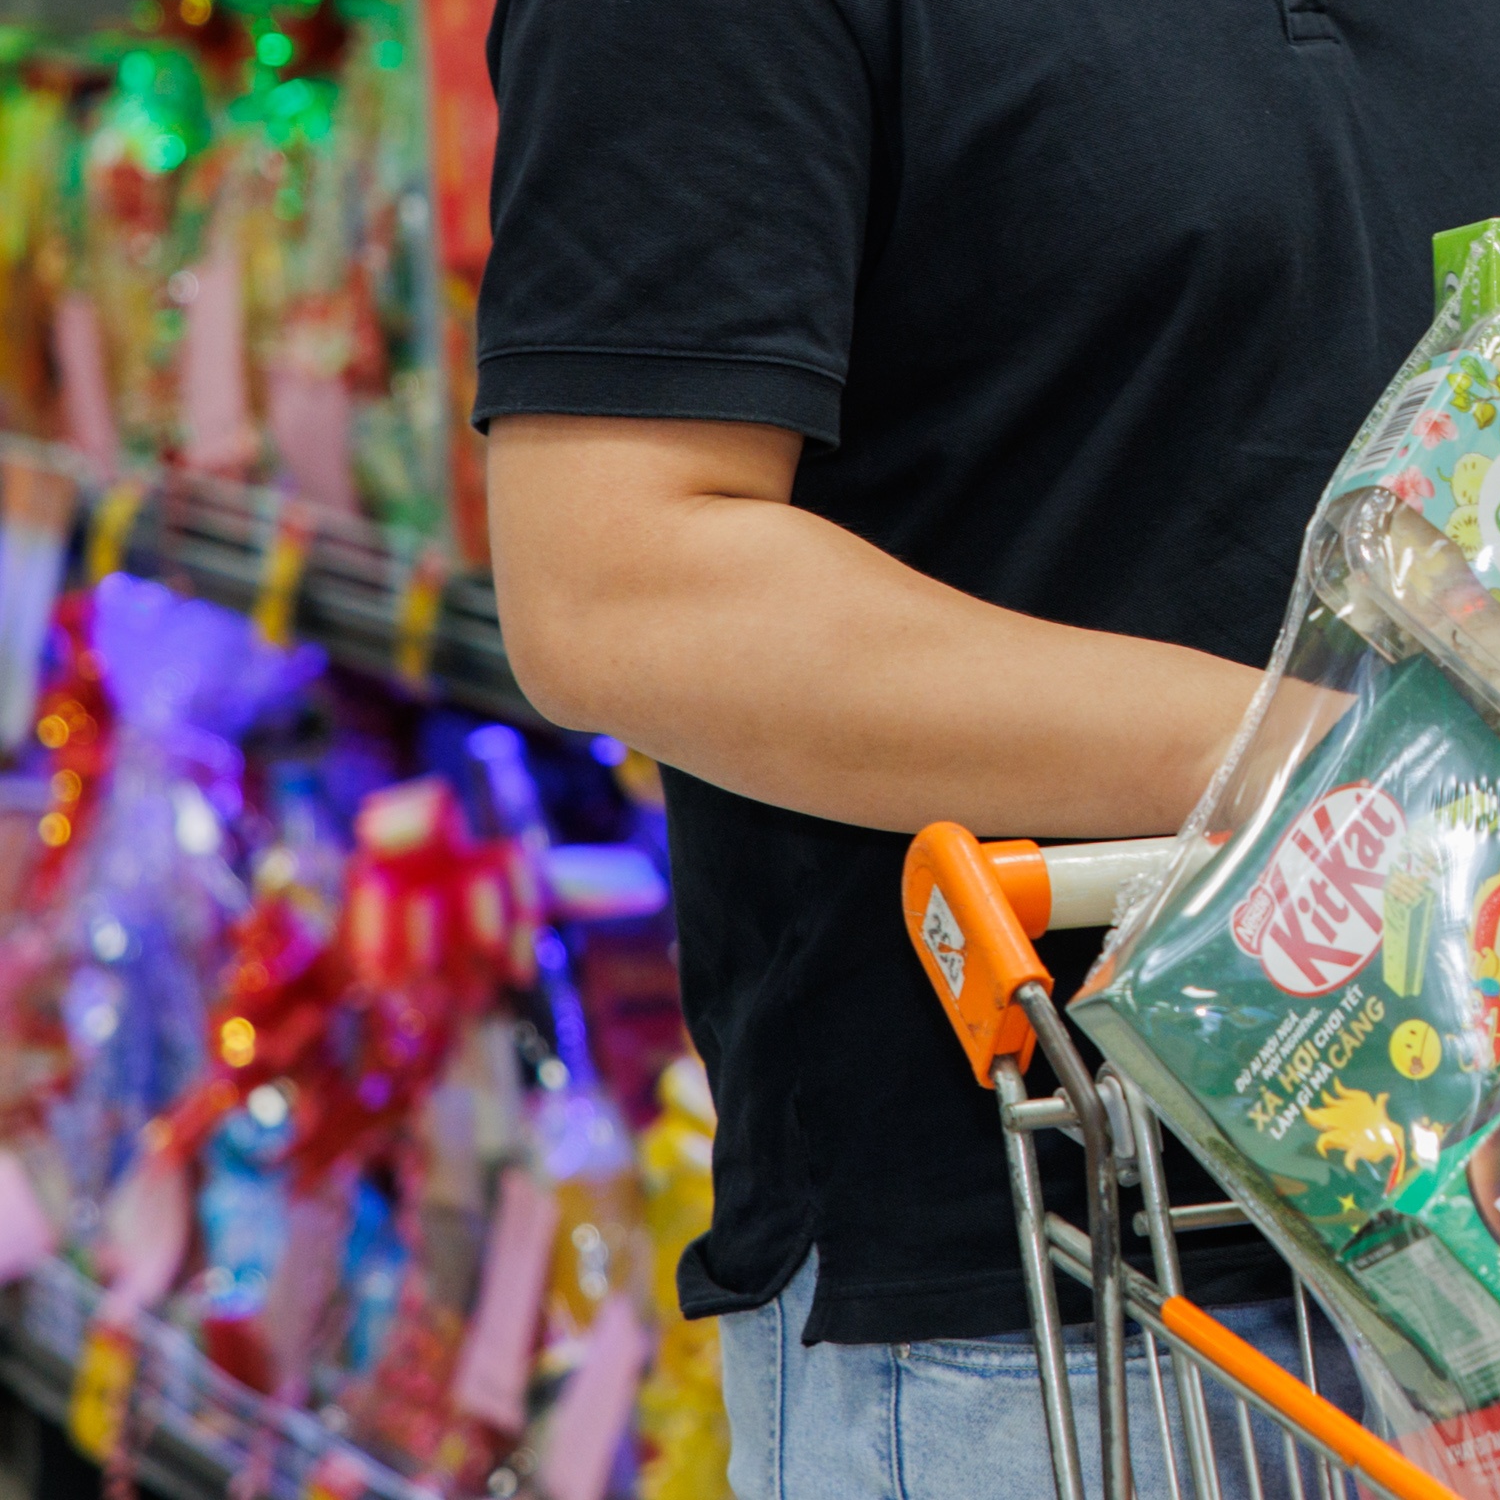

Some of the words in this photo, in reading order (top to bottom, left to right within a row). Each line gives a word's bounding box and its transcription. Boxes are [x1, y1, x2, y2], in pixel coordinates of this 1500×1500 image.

[1269, 792, 1397, 988] KitKat
[1313, 1008, 1346, 1050] CHƠI
[1339, 982, 1365, 1013] TẾT
